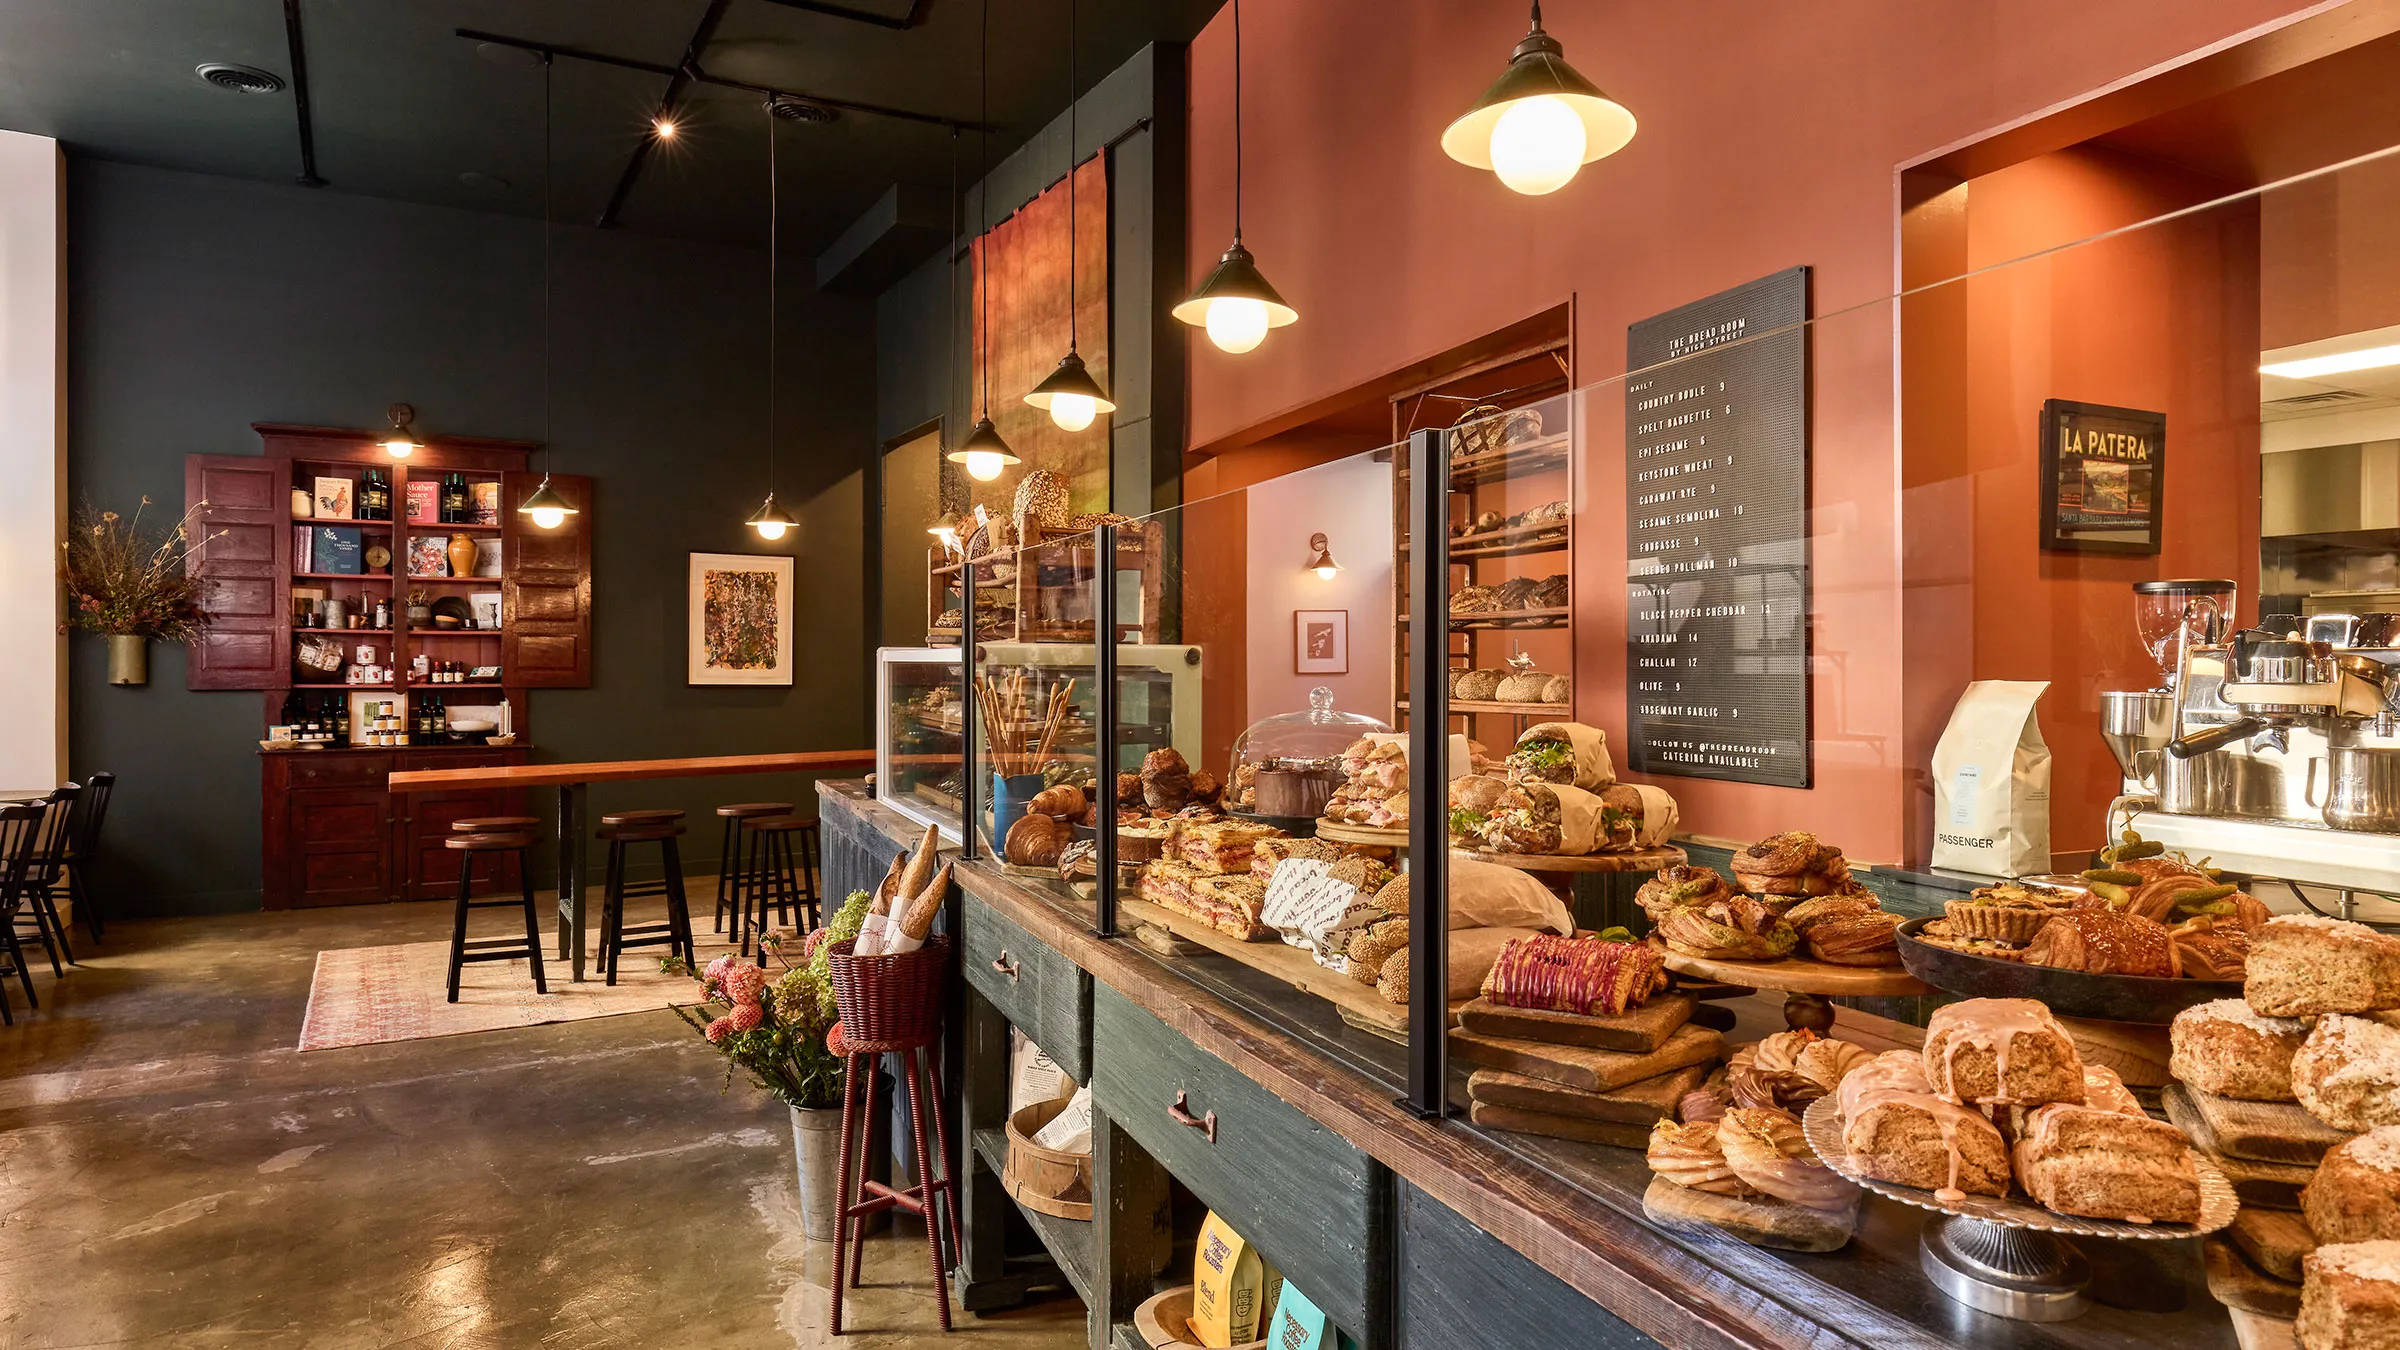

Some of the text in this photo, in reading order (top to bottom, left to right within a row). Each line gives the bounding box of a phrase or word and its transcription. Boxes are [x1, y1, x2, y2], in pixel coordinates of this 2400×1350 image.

[1669, 318, 1746, 350] THE BREAD ROOM
[1710, 330, 1744, 346] STREET
[1631, 381, 1654, 392] DAILY
[1638, 382, 1725, 411] COUNTRY BOULE 9
[1638, 423, 1664, 435] SPELT
[1668, 409, 1711, 428] BAGUETTE
[1639, 447, 1653, 458] EPI
[1656, 439, 1689, 455] SESAME
[2065, 428, 2147, 460] LA PATERA
[1639, 456, 1733, 482] KEYSTONE WHEAT 9
[1639, 484, 1716, 505] CARAWAY RYE 9
[1639, 505, 1744, 529] SESAME SEMOLINA 10
[1640, 537, 1700, 553] FOUGASSE 9
[1640, 563, 1671, 576] SEEDED
[1632, 589, 1671, 597] ROTATING
[1640, 604, 1771, 620] BLACK PEPPER CHEDDAR 13
[1640, 633, 1698, 643] ANADAMA 14
[1640, 658, 1698, 667] CHALLAH 12
[1639, 682, 1681, 692] OLIVE 9
[1639, 705, 1738, 718] ROSEMARY GARLIC 9
[1663, 752, 1759, 768] CATERING AVAILABLE
[1939, 833, 1993, 849] PASSENGER
[1207, 1229, 1232, 1259] Necessary
[1208, 1243, 1223, 1262] Coffee
[1203, 1249, 1223, 1274] Roasters
[1201, 1280, 1215, 1304] Blend
